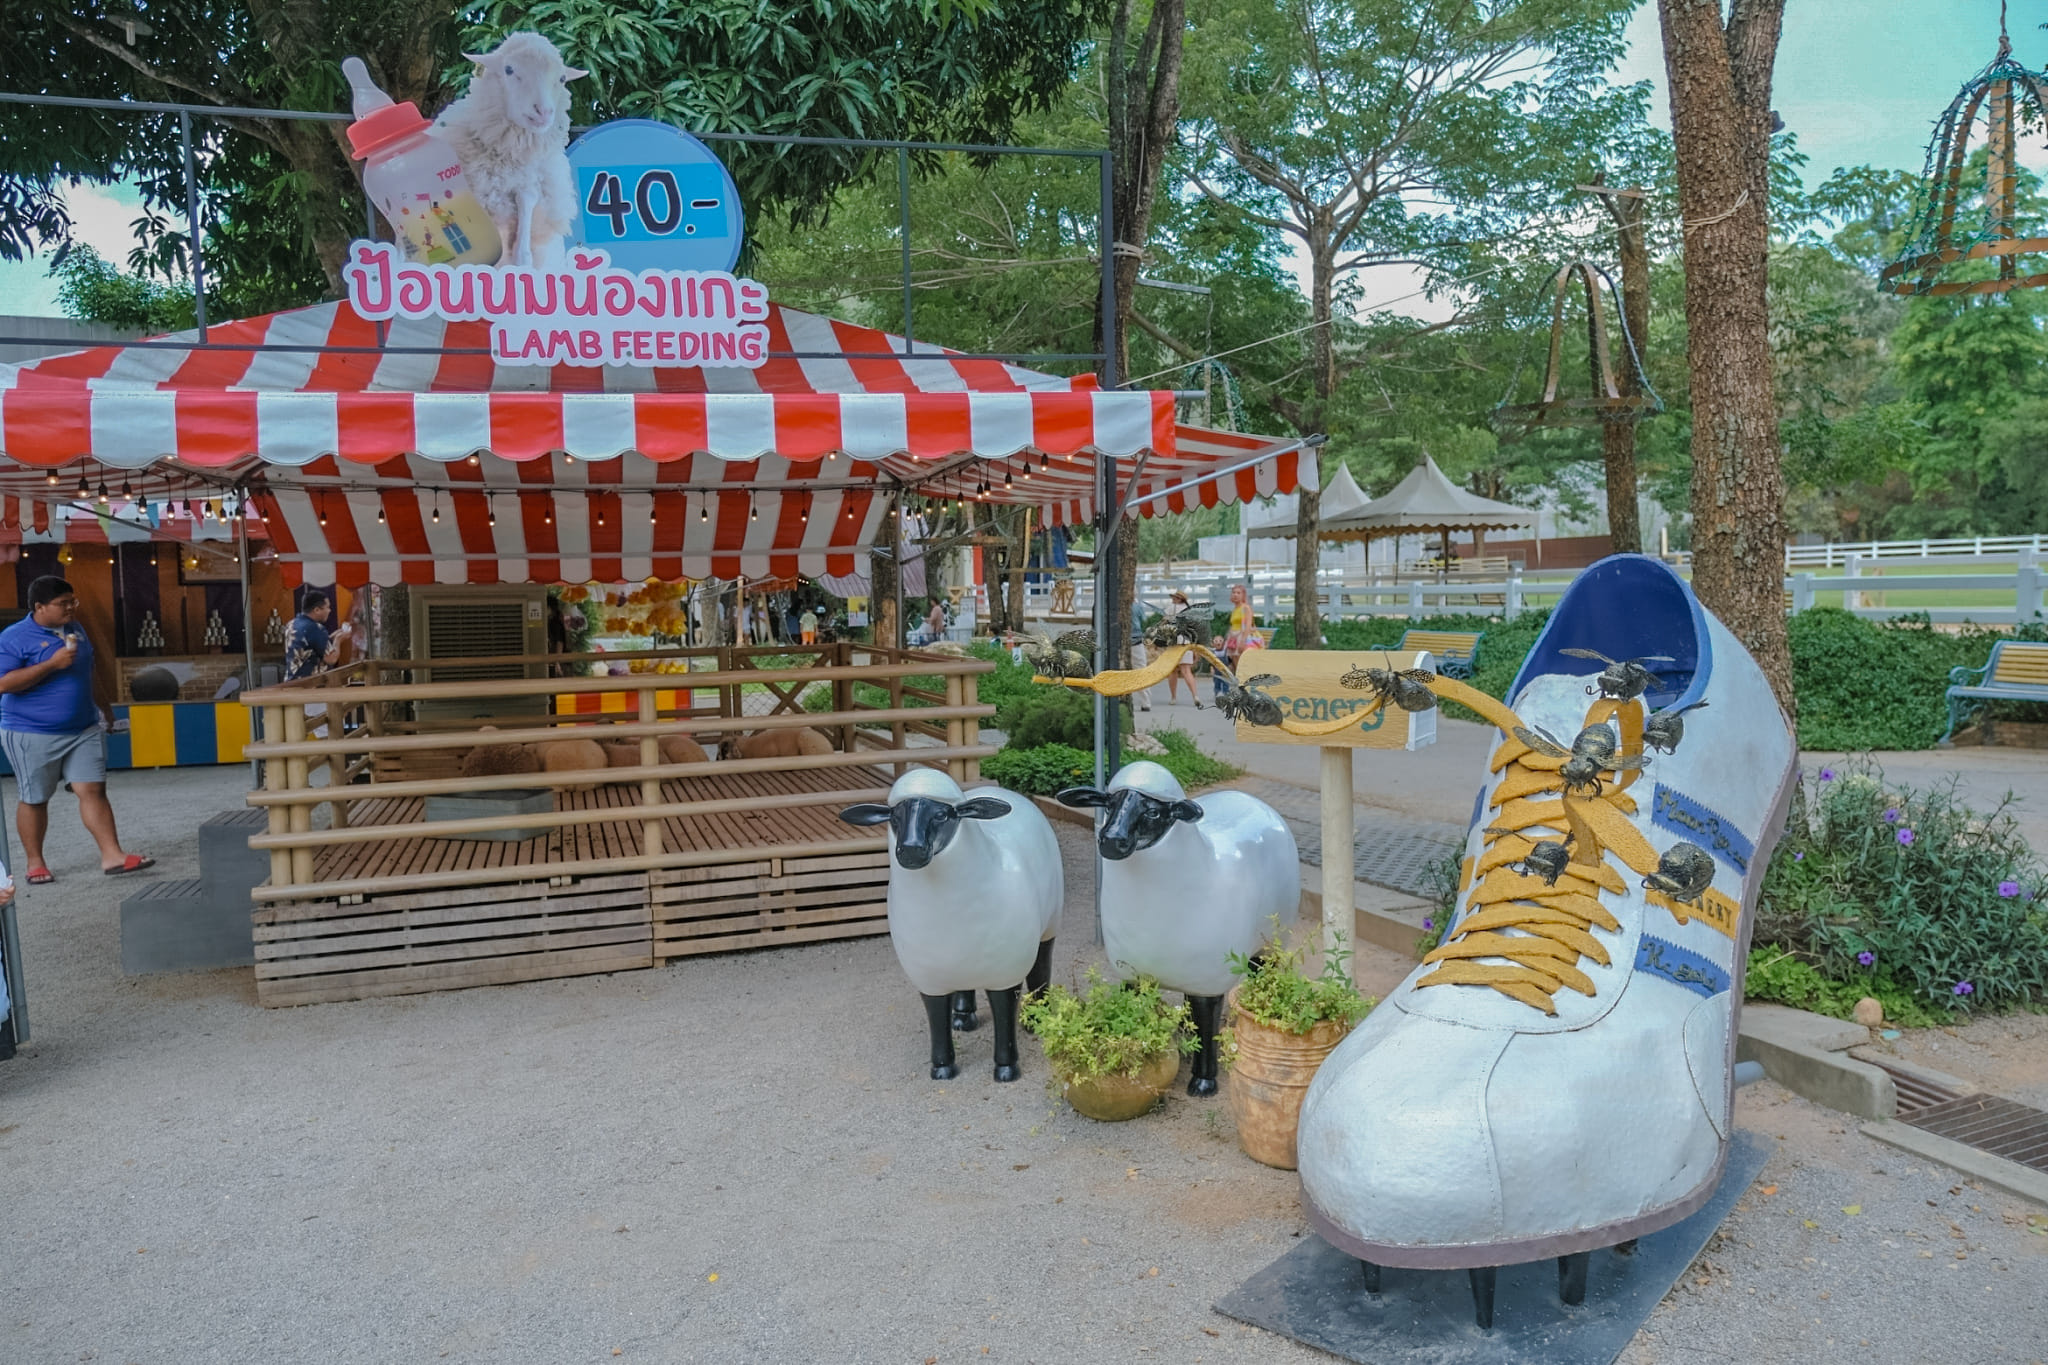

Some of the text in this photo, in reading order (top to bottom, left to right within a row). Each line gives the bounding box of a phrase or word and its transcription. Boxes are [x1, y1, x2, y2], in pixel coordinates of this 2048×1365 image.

[351, 246, 763, 319] ป้อนนมน้องแกะ
[498, 329, 762, 361] LAMB FEEDING
[1252, 685, 1385, 732] cenery
